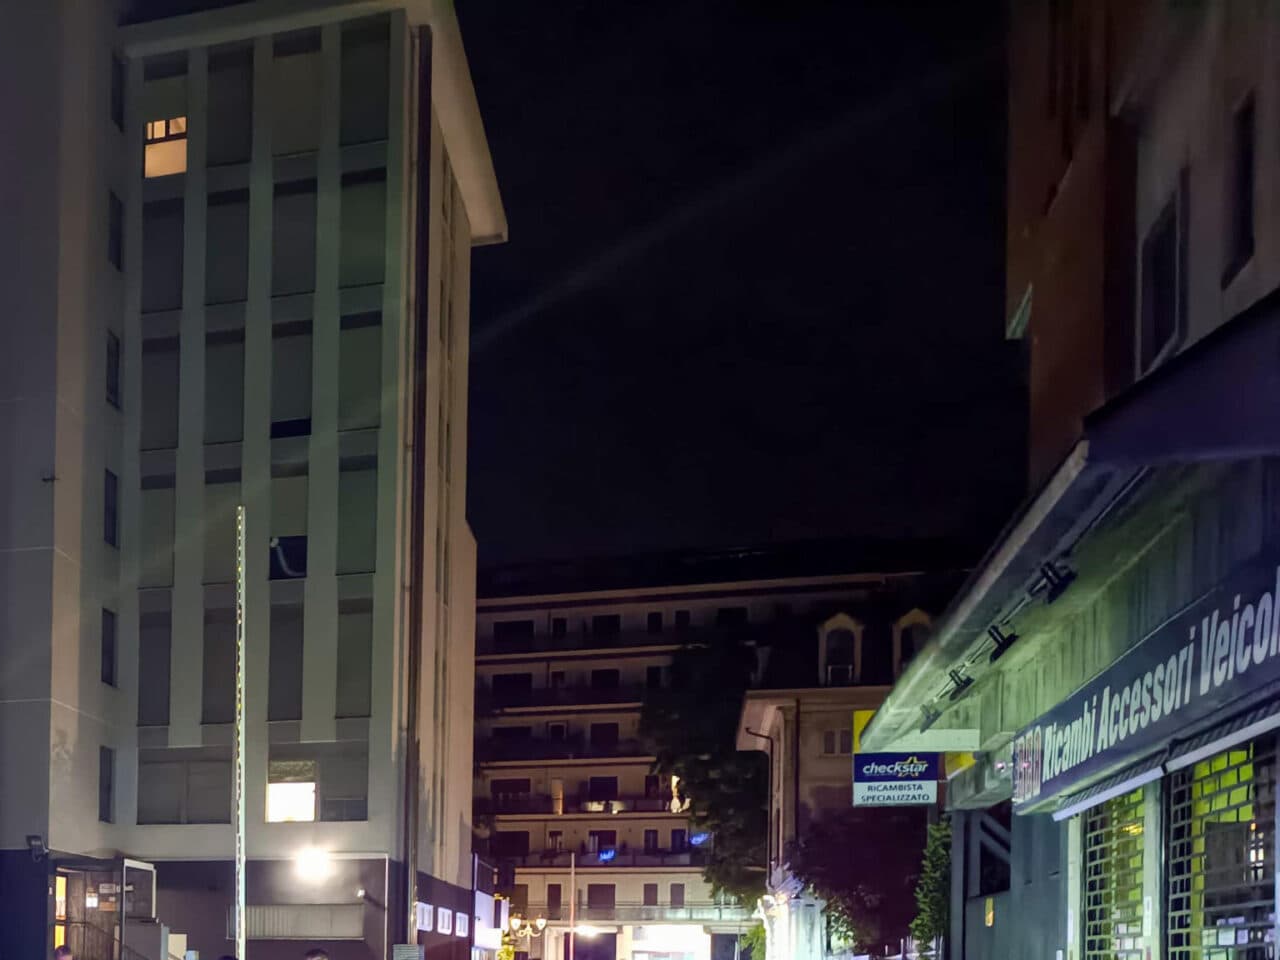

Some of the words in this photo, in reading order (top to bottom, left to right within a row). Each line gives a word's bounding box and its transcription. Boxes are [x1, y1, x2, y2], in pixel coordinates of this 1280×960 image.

[1042, 695, 1097, 783] Ricambi
[1097, 626, 1196, 752] Accessori
[1199, 566, 1280, 696] Veicol
[862, 761, 928, 775] checkstar
[867, 783, 923, 792] RICAMBISTA
[861, 793, 930, 802] SPECIALIZZATO
